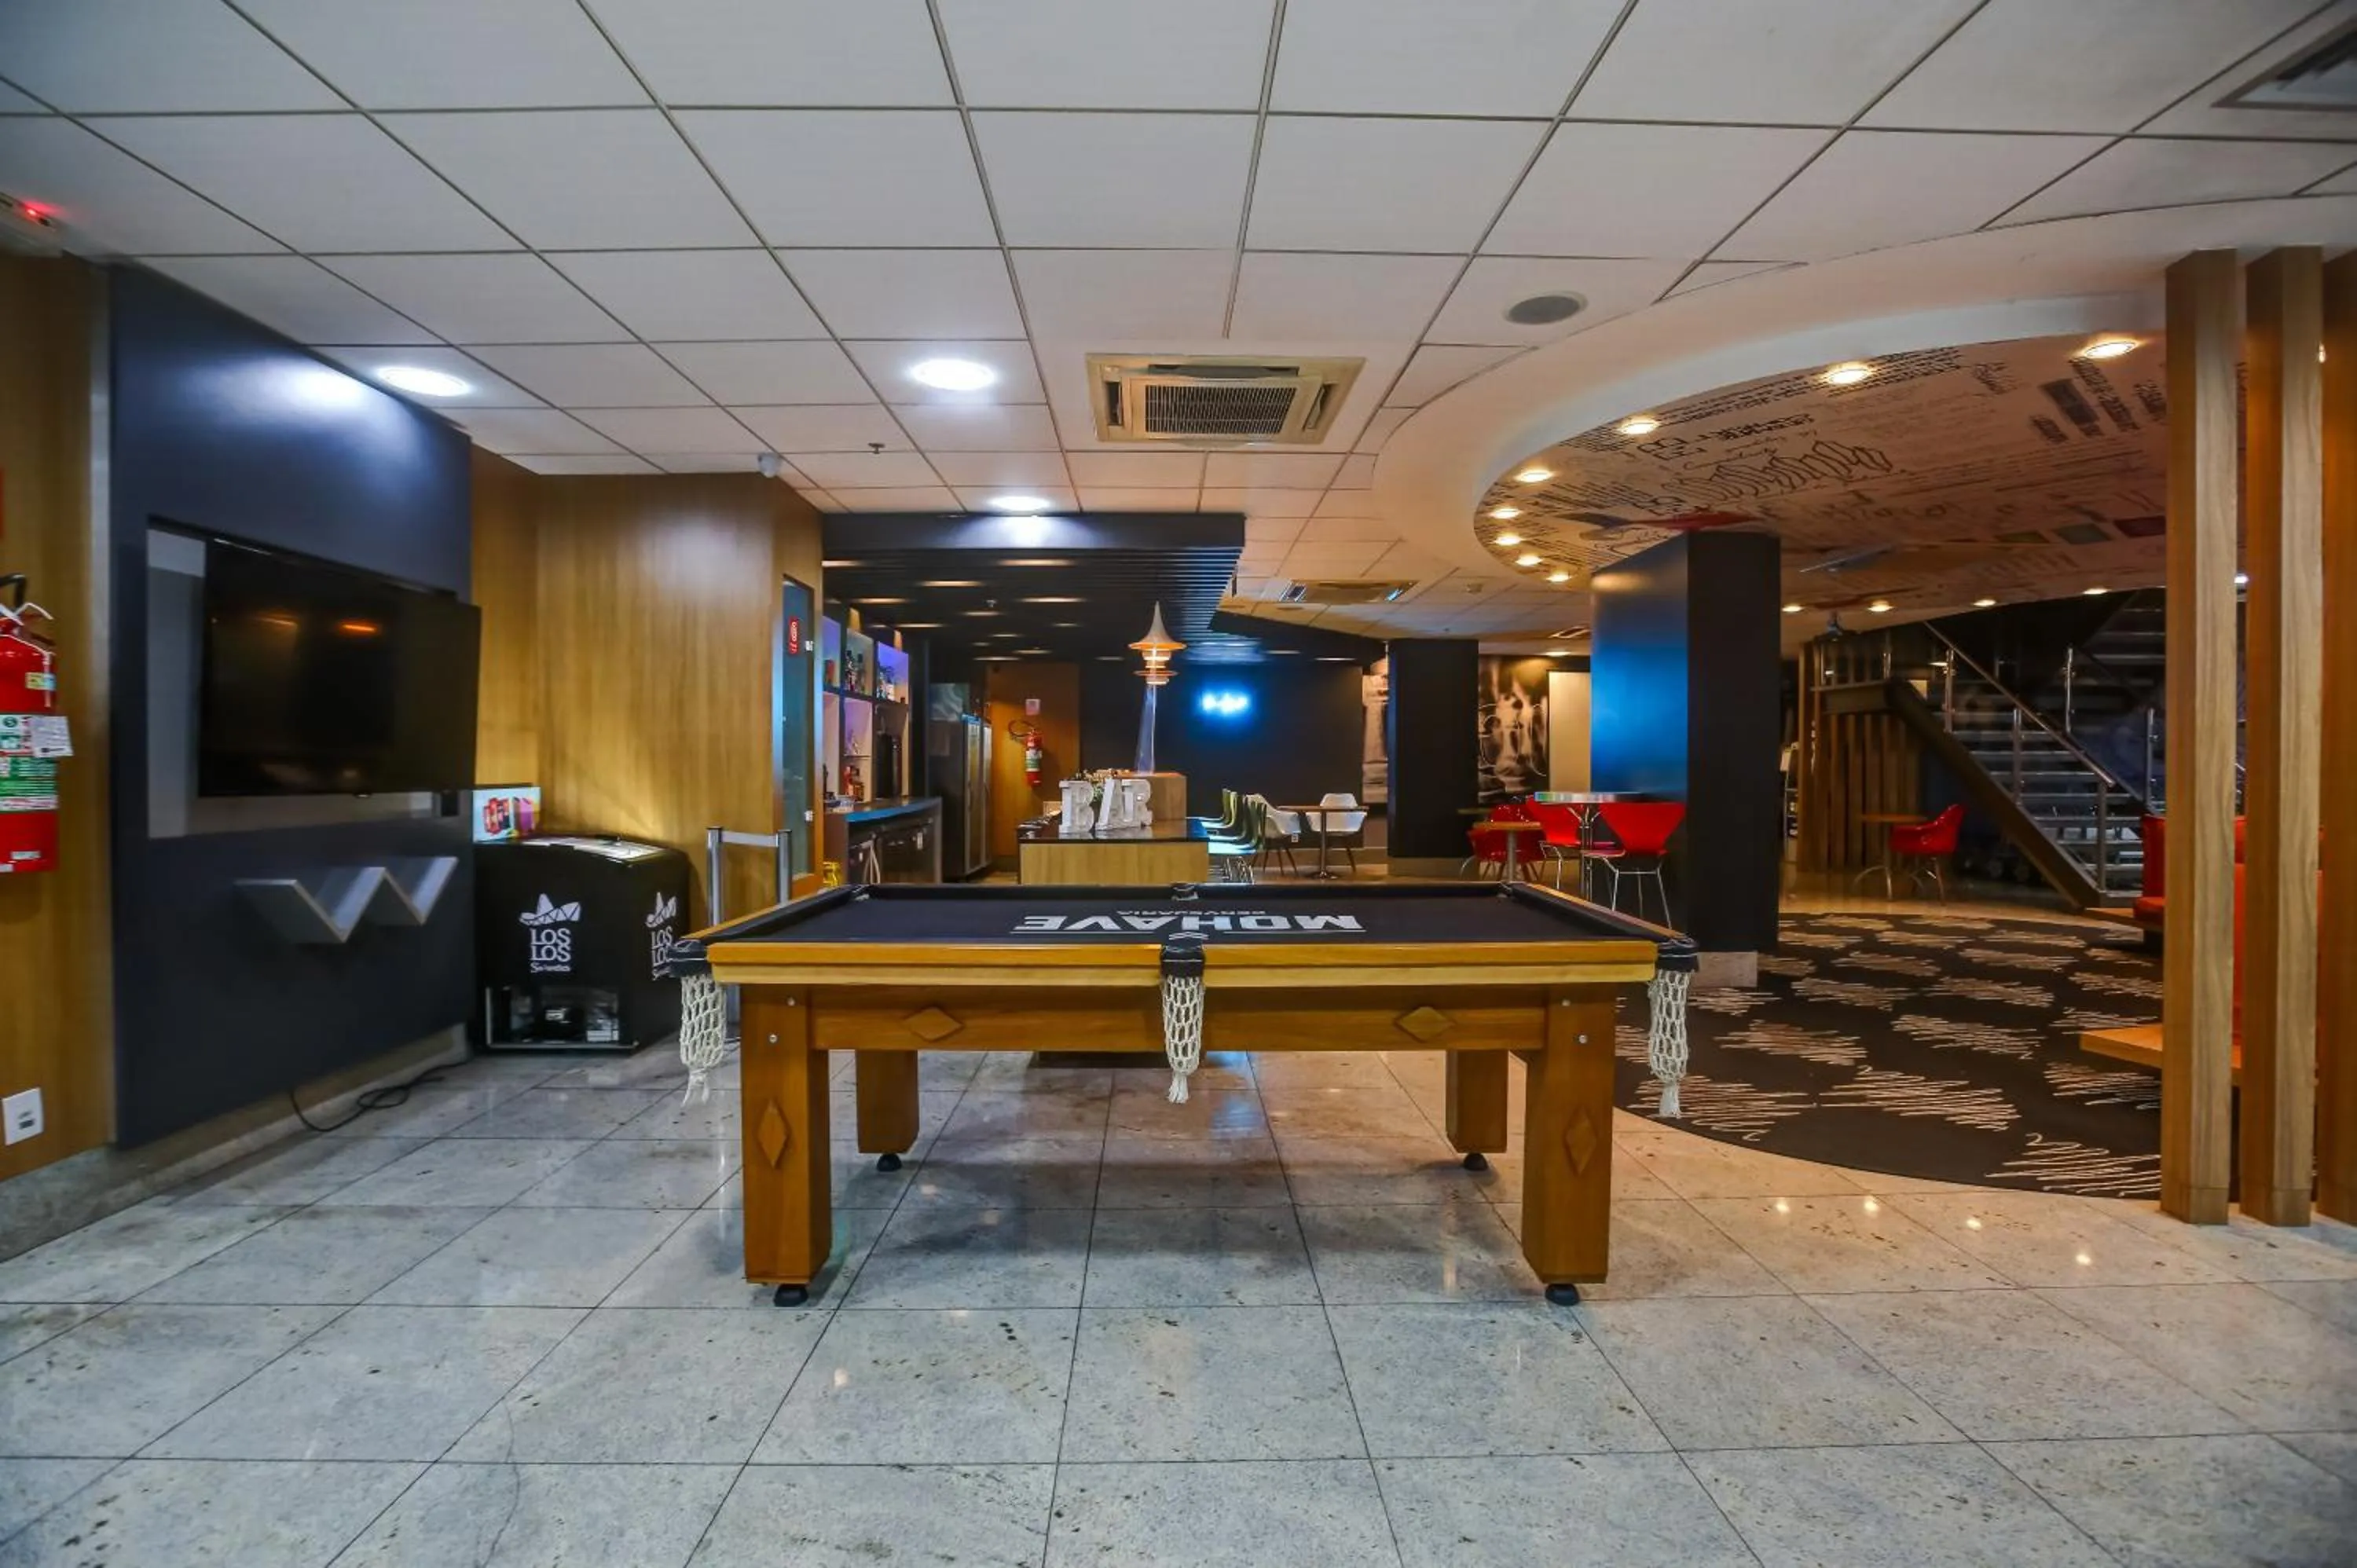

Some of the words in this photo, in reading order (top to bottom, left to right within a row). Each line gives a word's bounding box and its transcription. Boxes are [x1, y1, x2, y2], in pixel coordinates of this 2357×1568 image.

[1058, 778, 1153, 833] BAR
[1013, 915, 1363, 930] MOHAVE
[530, 928, 571, 945] LOS
[651, 925, 673, 949] LOS
[530, 944, 571, 962] LOS
